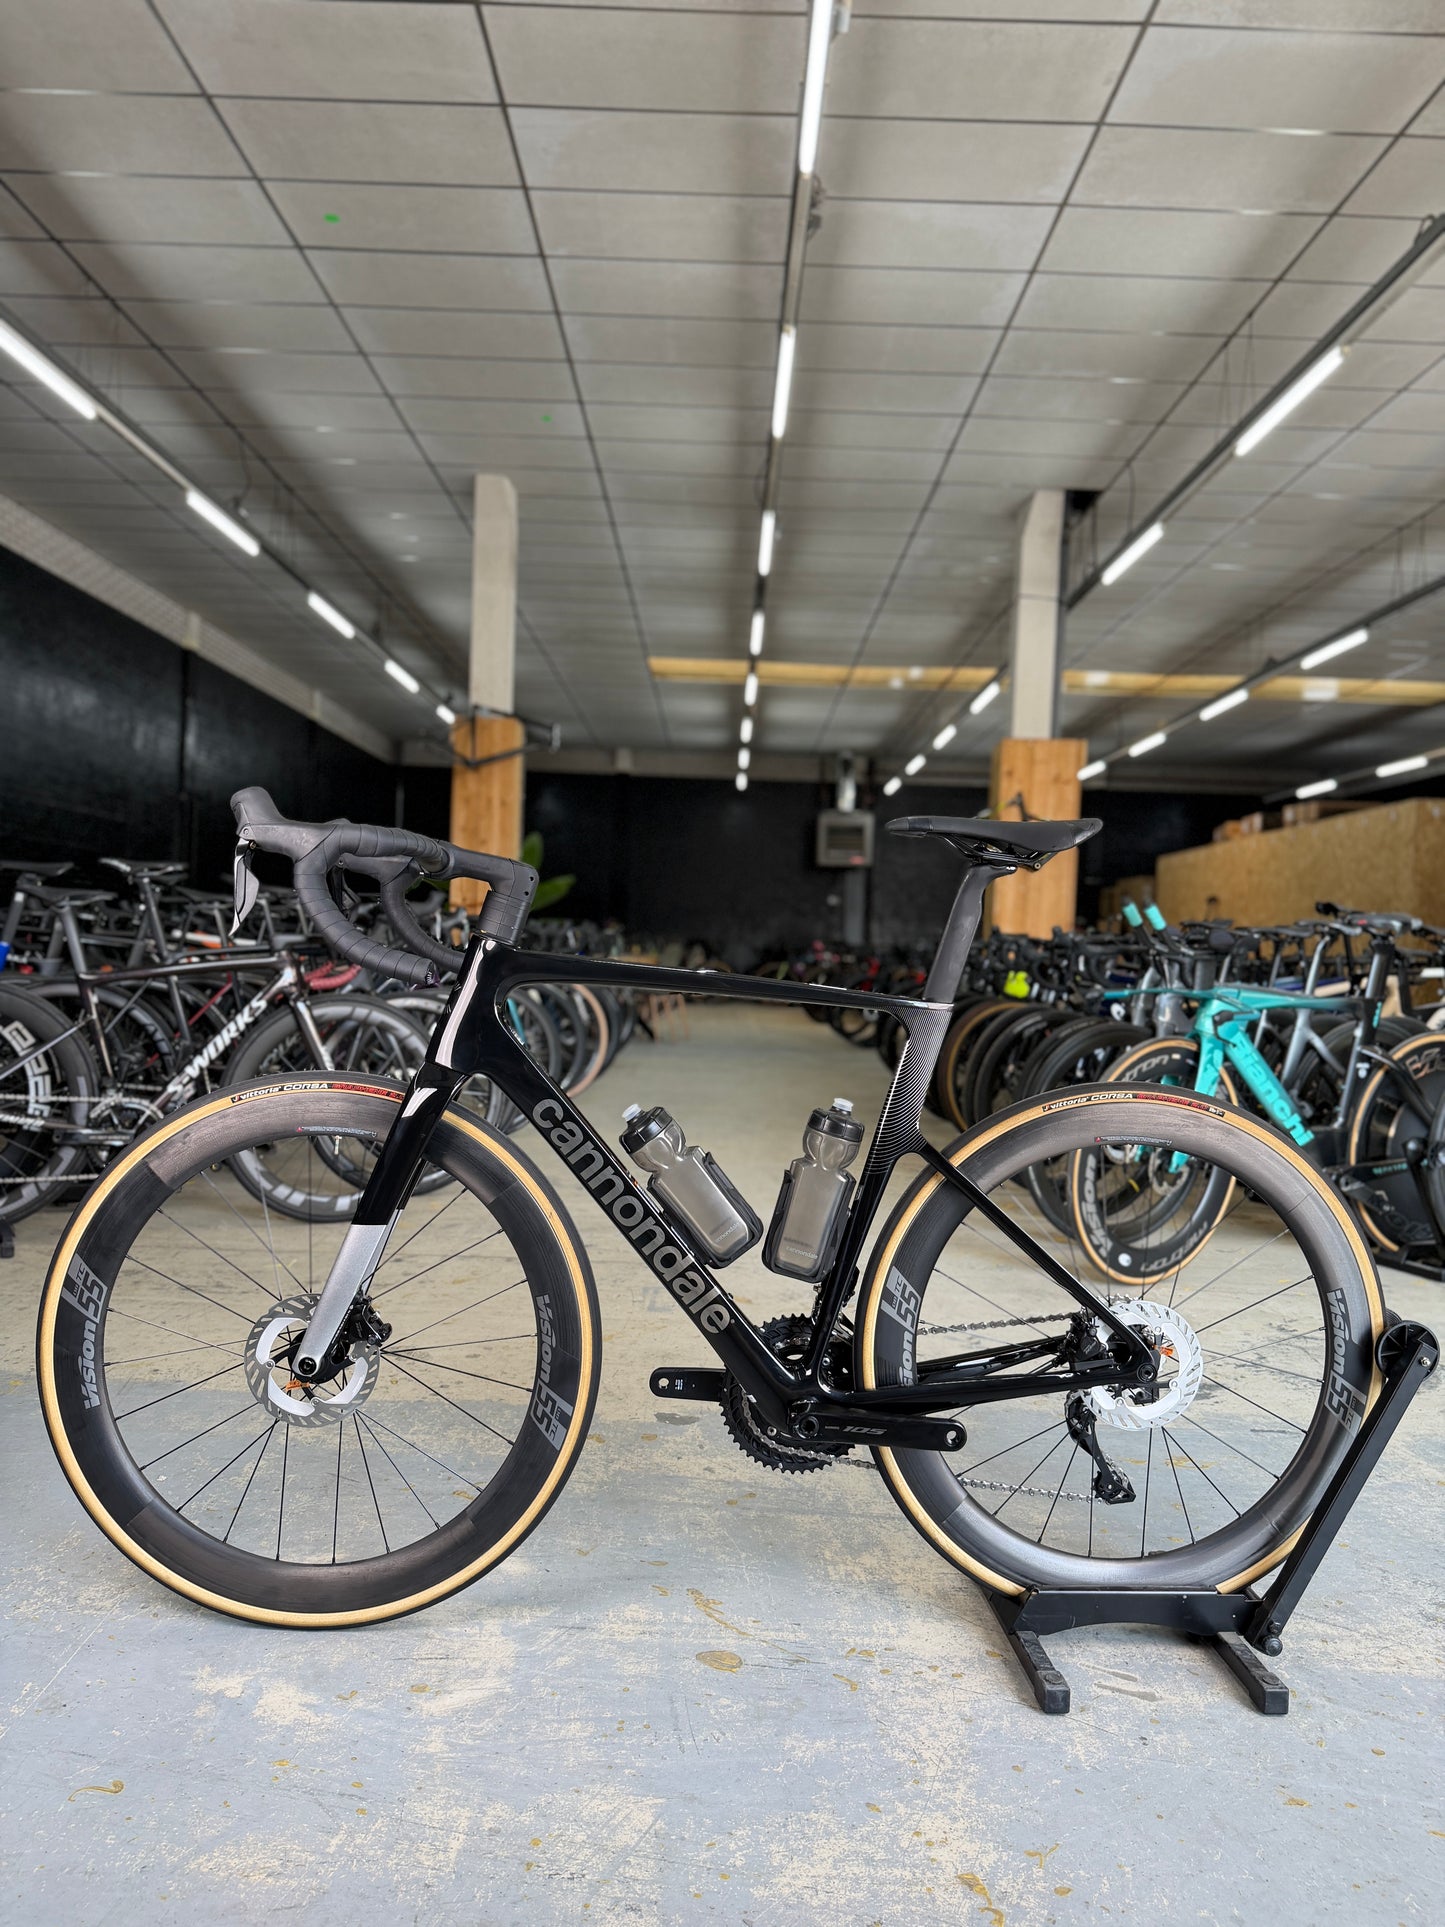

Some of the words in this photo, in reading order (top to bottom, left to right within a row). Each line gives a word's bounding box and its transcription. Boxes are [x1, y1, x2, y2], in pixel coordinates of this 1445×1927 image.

[167, 991, 268, 1099] S-WORKS
[240, 1087, 280, 1100] vittoria
[283, 1083, 329, 1091] CORSA
[1050, 1097, 1087, 1110] vittoria
[1091, 1093, 1133, 1101] CORSA
[1230, 1031, 1315, 1147] Bianchi
[532, 1098, 731, 1334] cannondale
[77, 1270, 103, 1320] 55
[896, 1283, 919, 1331] 55
[533, 1382, 556, 1434] 55
[1327, 1376, 1352, 1422] 55
[842, 1426, 887, 1435] 105
